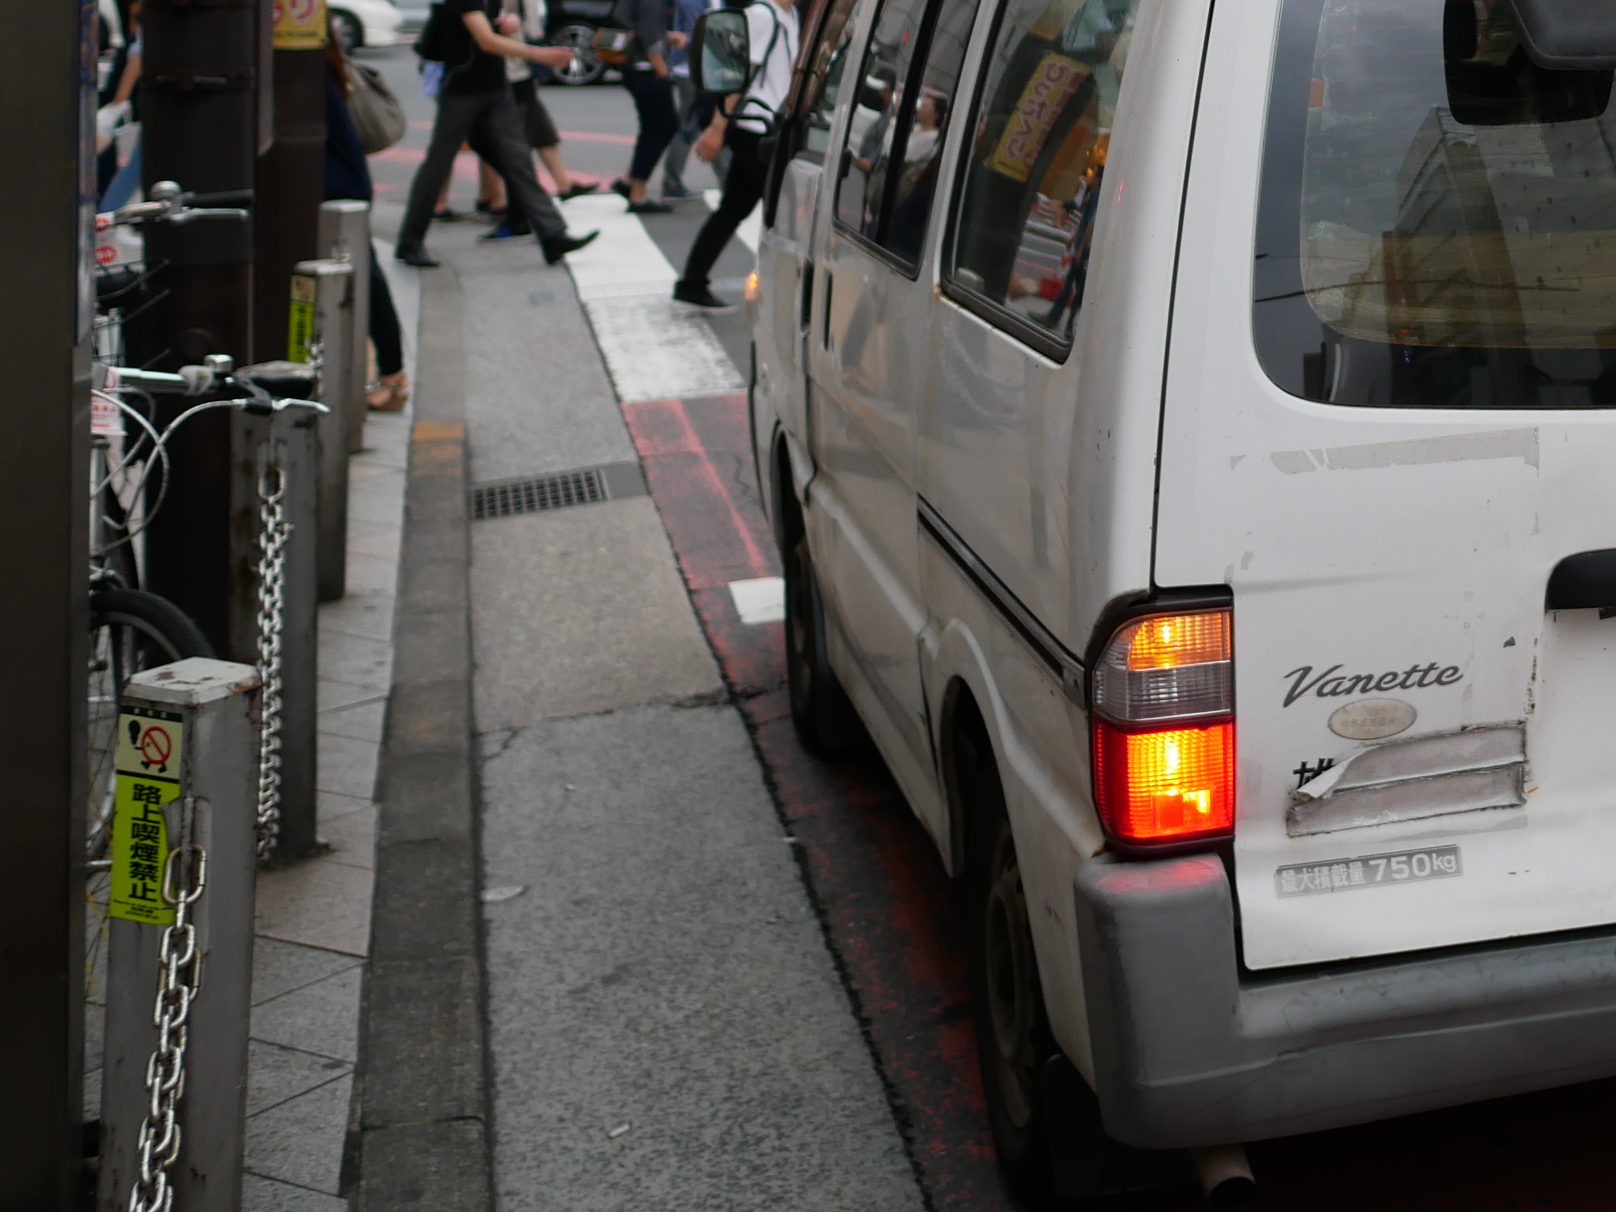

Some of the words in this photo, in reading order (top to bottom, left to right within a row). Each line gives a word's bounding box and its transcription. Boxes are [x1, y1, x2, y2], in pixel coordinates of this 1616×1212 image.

[1283, 661, 1464, 709] Vanette
[128, 784, 163, 903] 路上喫煙禁止
[1368, 852, 1457, 882] 750kg
